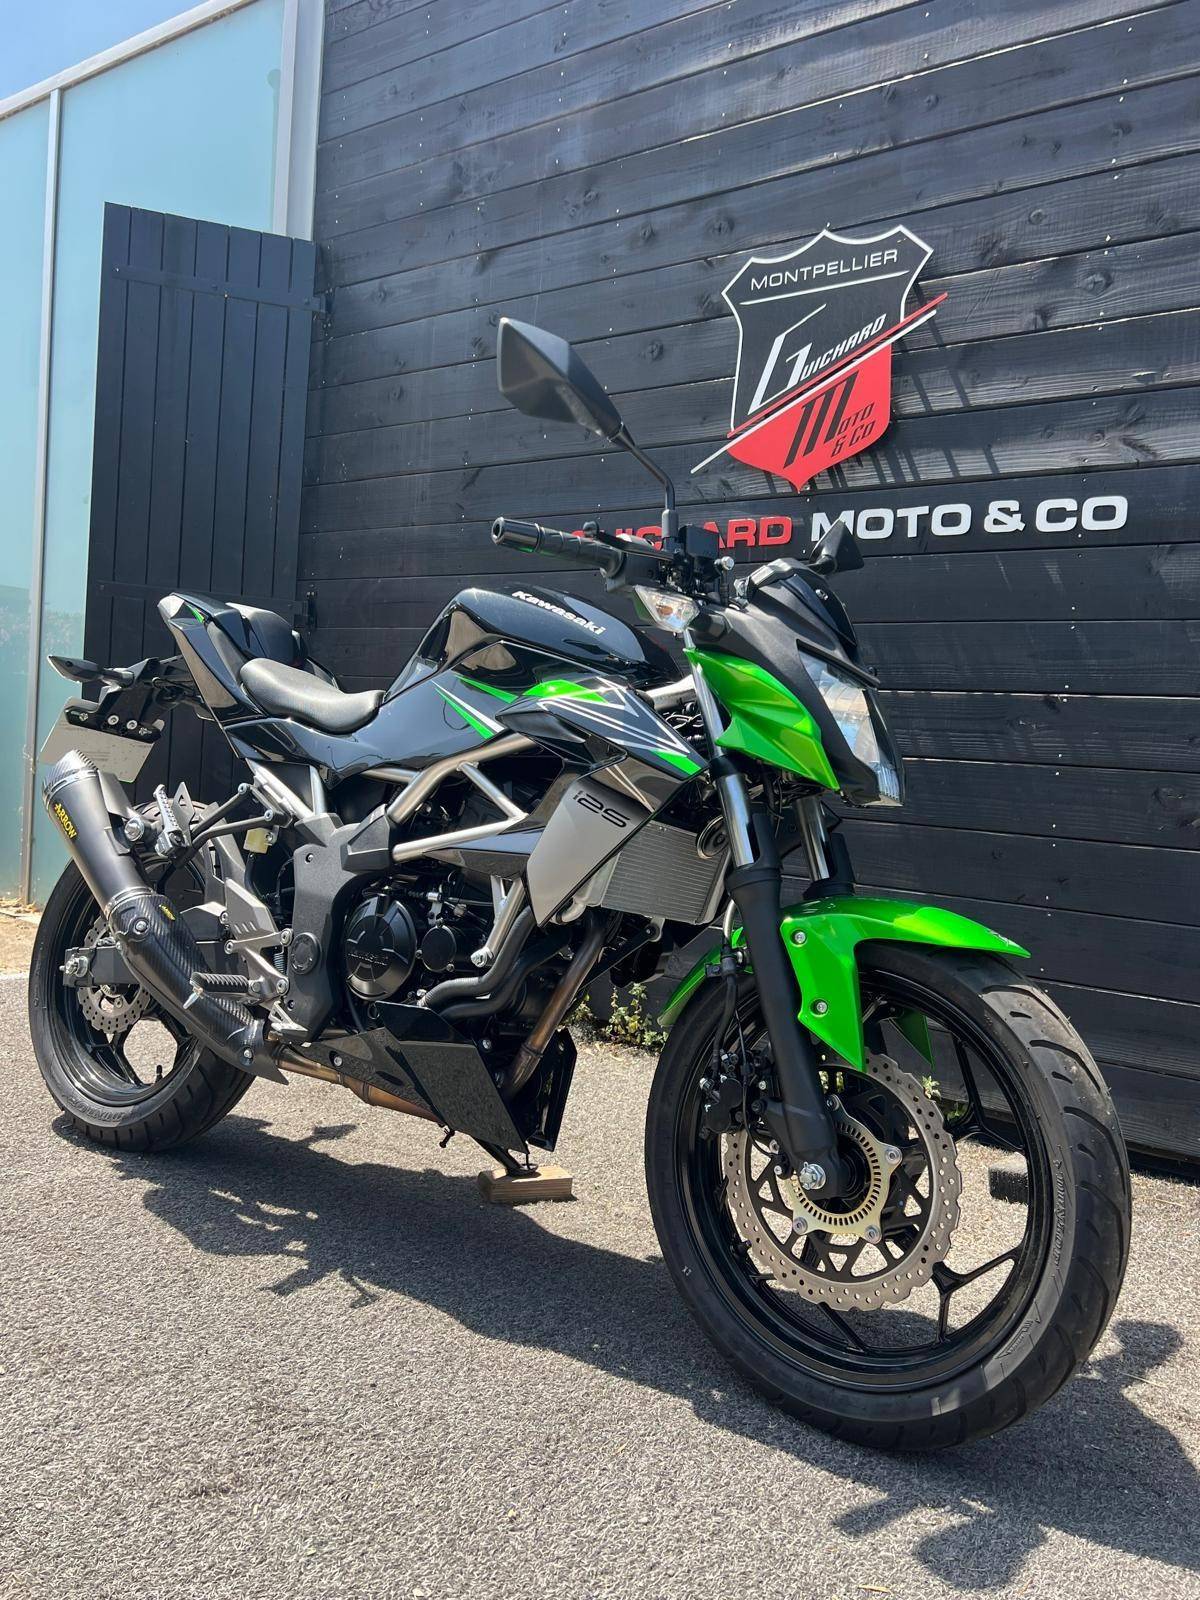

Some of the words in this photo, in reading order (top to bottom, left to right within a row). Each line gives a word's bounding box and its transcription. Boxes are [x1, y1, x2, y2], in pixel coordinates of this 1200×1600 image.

[751, 249, 898, 291] MONTPELLIER
[831, 434, 845, 458] &
[849, 420, 876, 448] CO
[811, 503, 972, 542] MOTO
[984, 500, 1026, 532] &
[1035, 496, 1128, 532] CO
[512, 591, 606, 635] Kawasaki
[54, 803, 77, 839] ARROW
